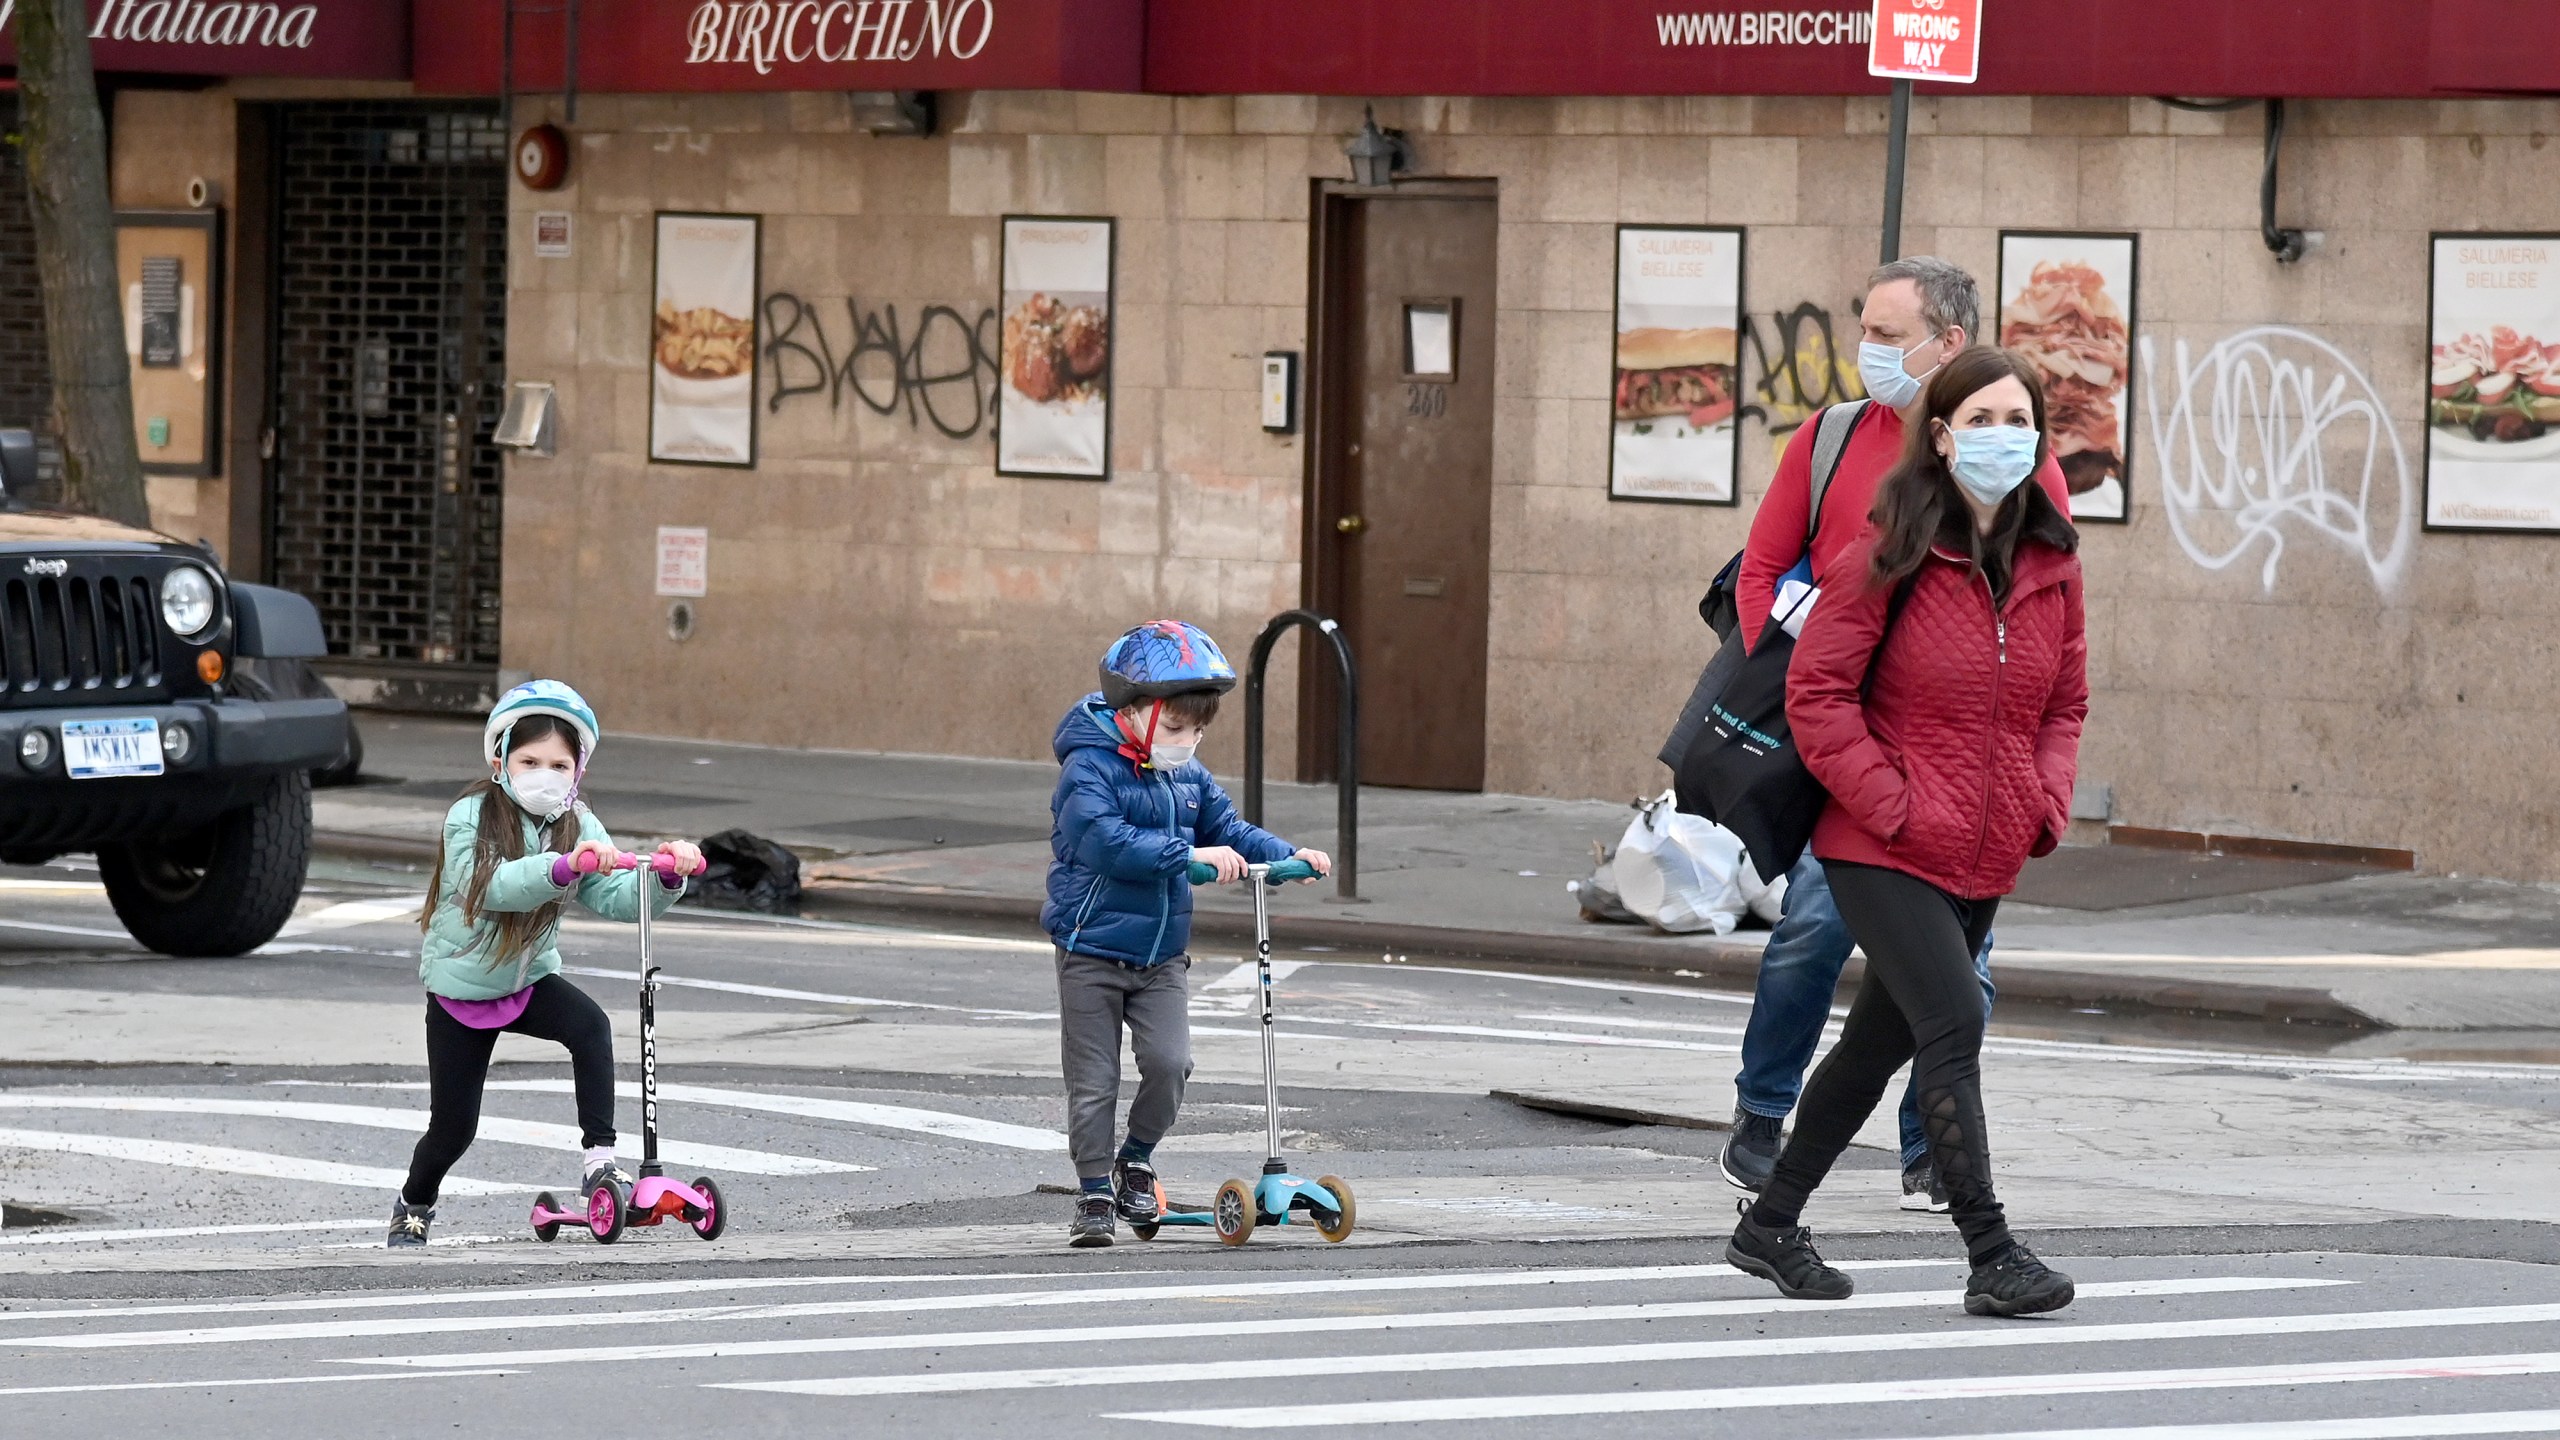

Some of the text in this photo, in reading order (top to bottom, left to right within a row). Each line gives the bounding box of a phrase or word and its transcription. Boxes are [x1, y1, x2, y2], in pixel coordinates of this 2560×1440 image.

[88, 0, 318, 48] Italiana
[1892, 12, 1960, 42] WRONG
[683, 0, 994, 75] BIRICCHINO
[1903, 40, 1945, 67] WAY
[1637, 239, 1713, 255] SALUMERIA
[2459, 247, 2548, 264] SALUMERIA
[1640, 261, 1704, 277] BIELLESE
[2465, 271, 2538, 289] BIELLESE
[2440, 503, 2550, 521] NYCsalami.com
[23, 556, 68, 578] Jeep
[1721, 711, 1739, 727] and
[1737, 722, 1781, 749] Company
